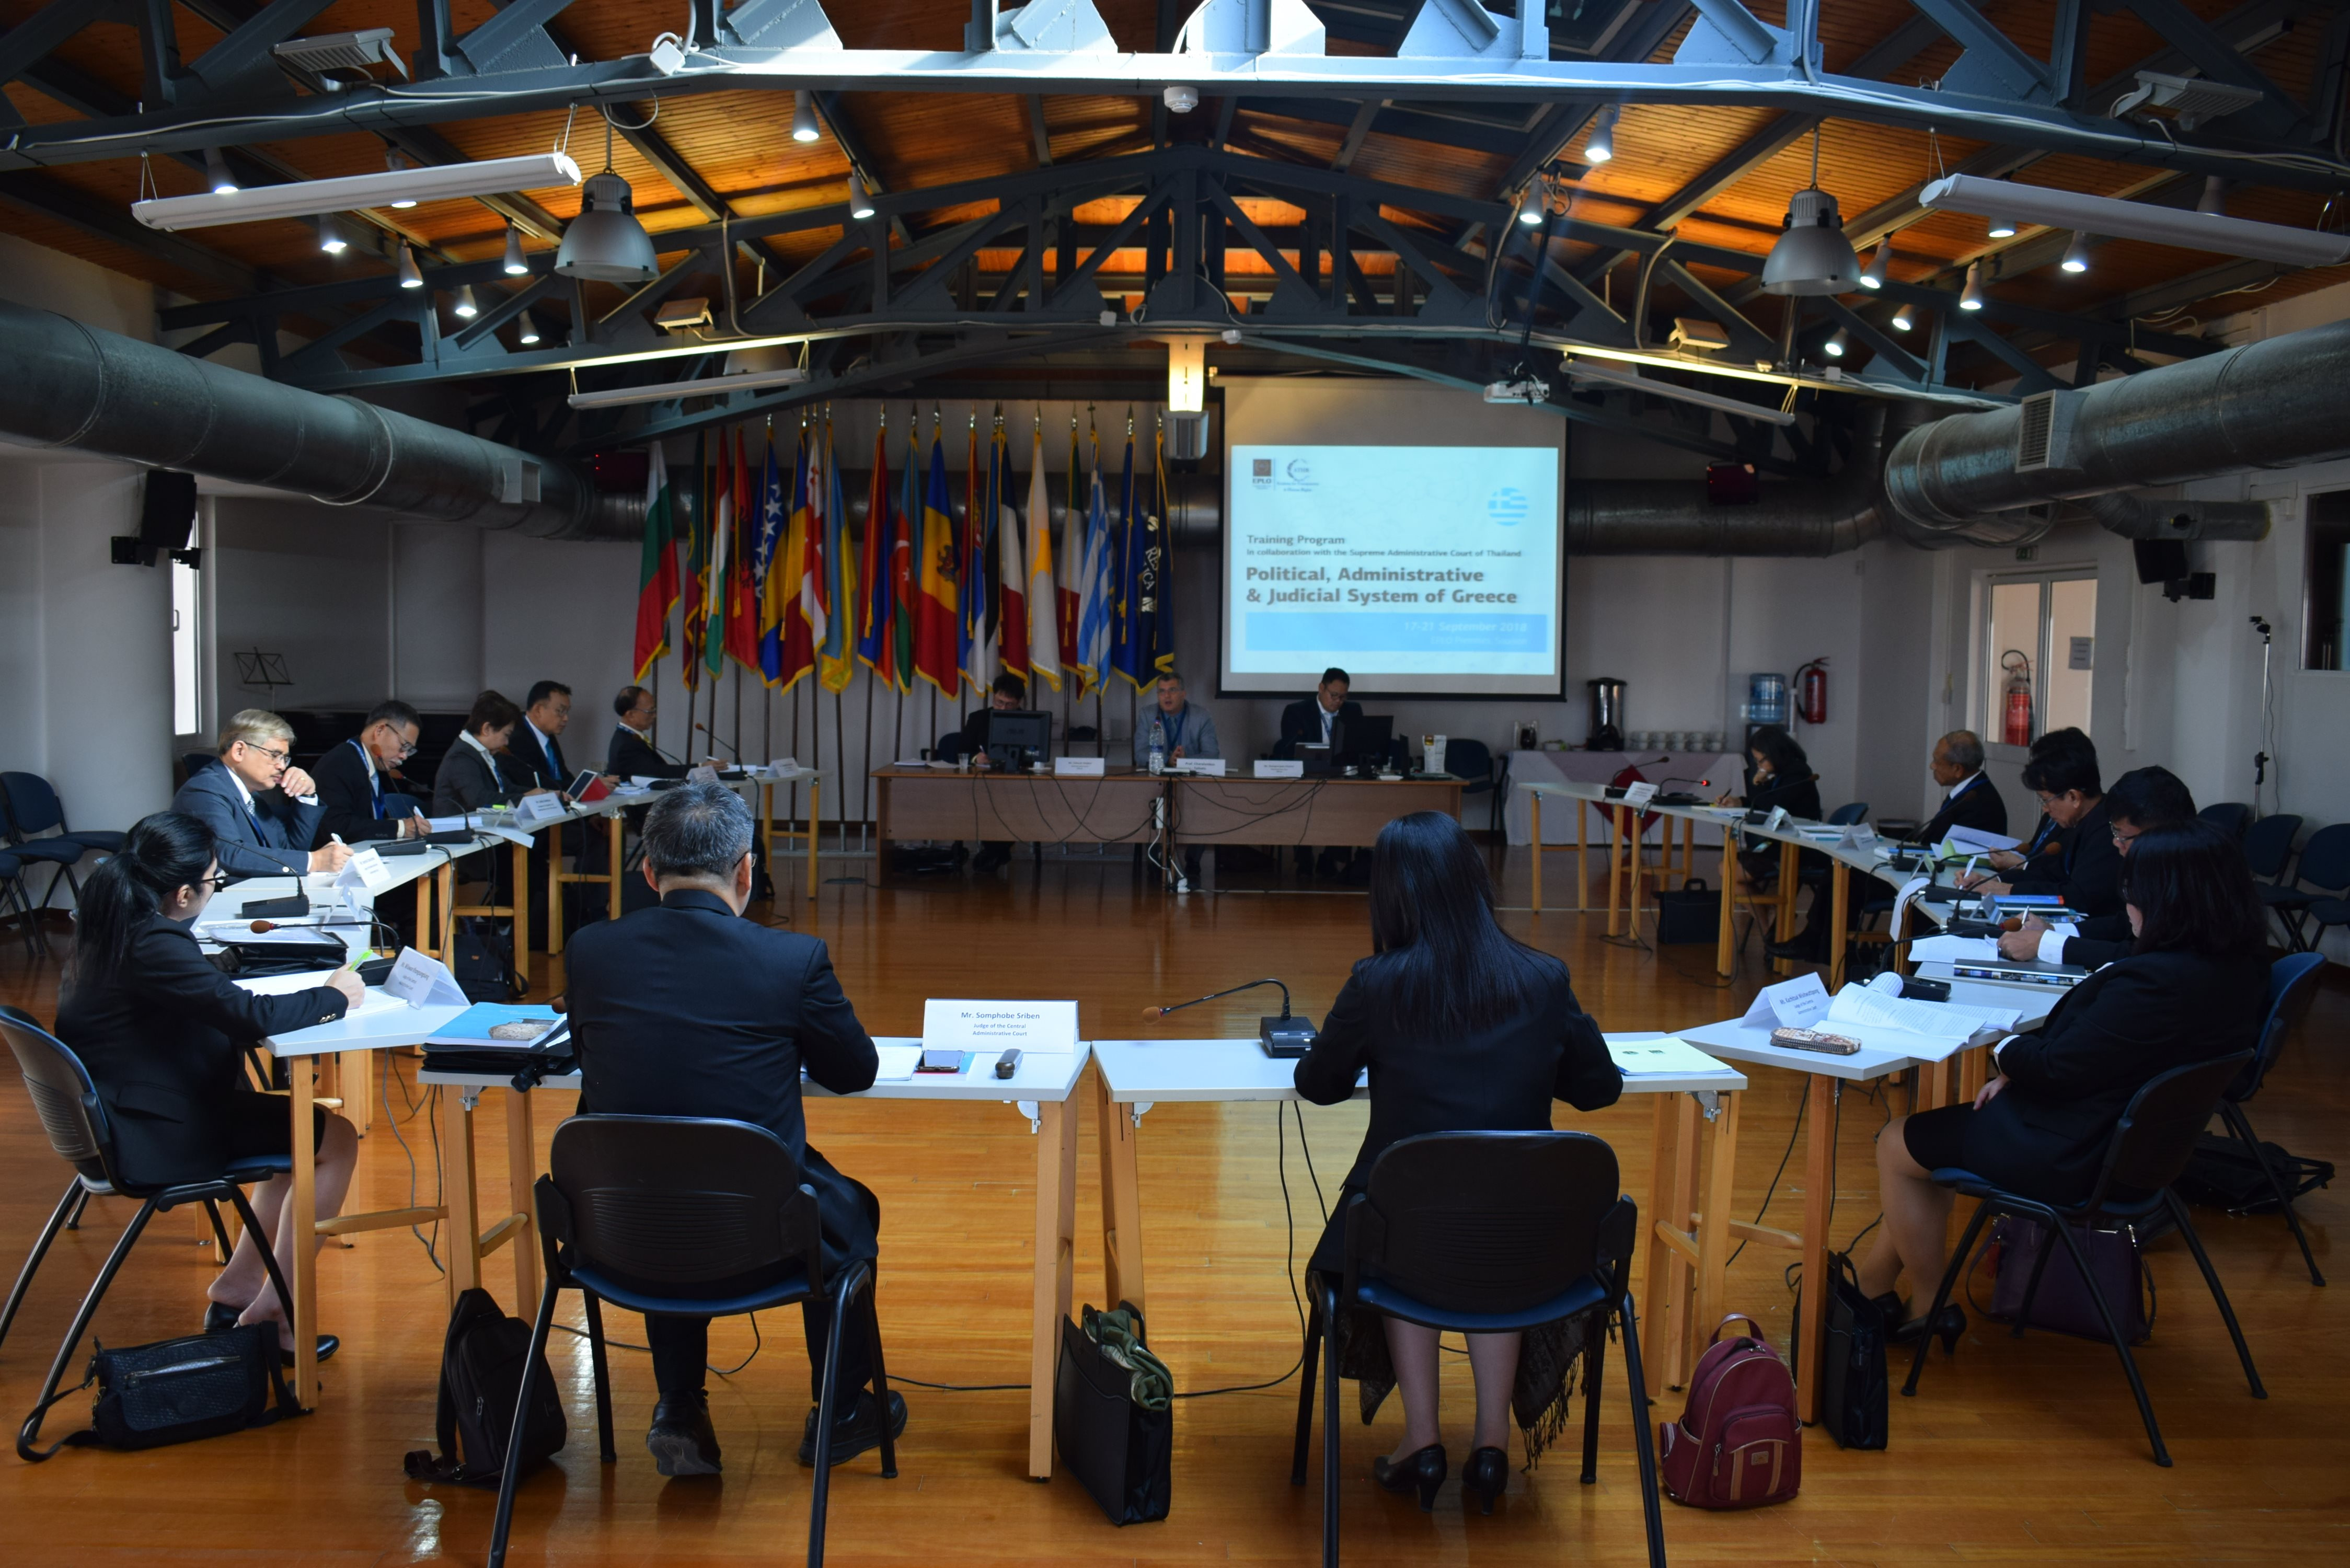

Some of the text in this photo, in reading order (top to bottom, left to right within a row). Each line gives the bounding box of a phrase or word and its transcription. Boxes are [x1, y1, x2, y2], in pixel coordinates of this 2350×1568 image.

[1247, 535, 1345, 546] Training Program
[1247, 567, 1484, 583] Political, Administrative
[1246, 587, 1517, 606] & Judicial System of Greece
[1404, 621, 1528, 633] 17-21 September 2018
[976, 1012, 1015, 1020] Somphobe
